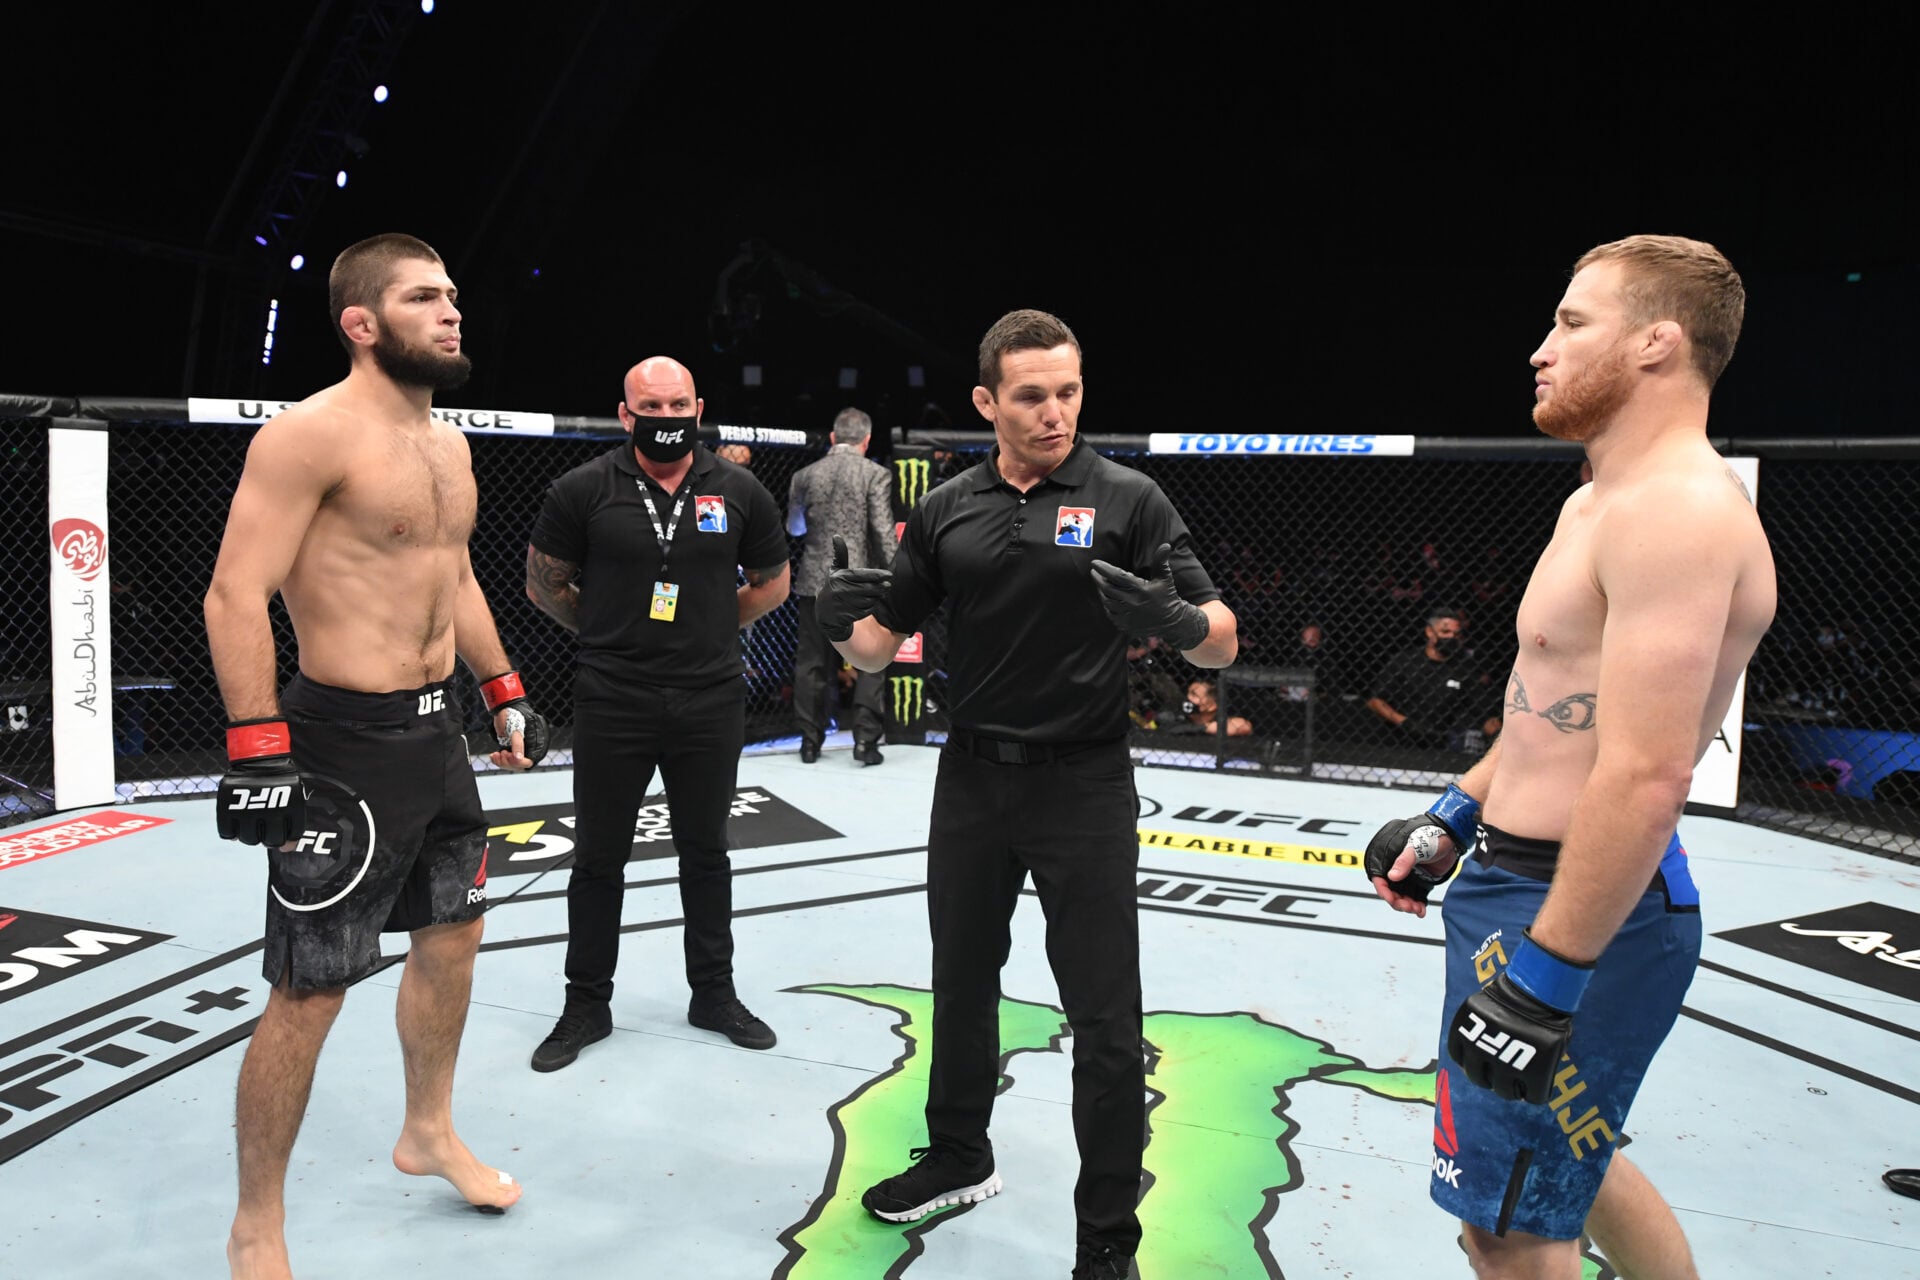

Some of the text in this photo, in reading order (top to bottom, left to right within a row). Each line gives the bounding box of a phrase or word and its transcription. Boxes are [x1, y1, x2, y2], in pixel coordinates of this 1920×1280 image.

[655, 429, 684, 444] UFC
[718, 425, 806, 445] VEGAS STRONGER
[1178, 434, 1377, 453] TOYO TIRES
[644, 499, 657, 515] UFC
[673, 499, 684, 516] UFC
[666, 523, 677, 541] UFC
[228, 785, 292, 811] UFC
[73, 819, 155, 841] WAR
[1171, 806, 1362, 836] UFC
[296, 830, 338, 855] FC
[1137, 833, 1286, 859] ILABLE
[1137, 878, 1333, 919] UFC
[1471, 929, 1503, 960] JUSTIN
[1458, 1012, 1537, 1071] UFC
